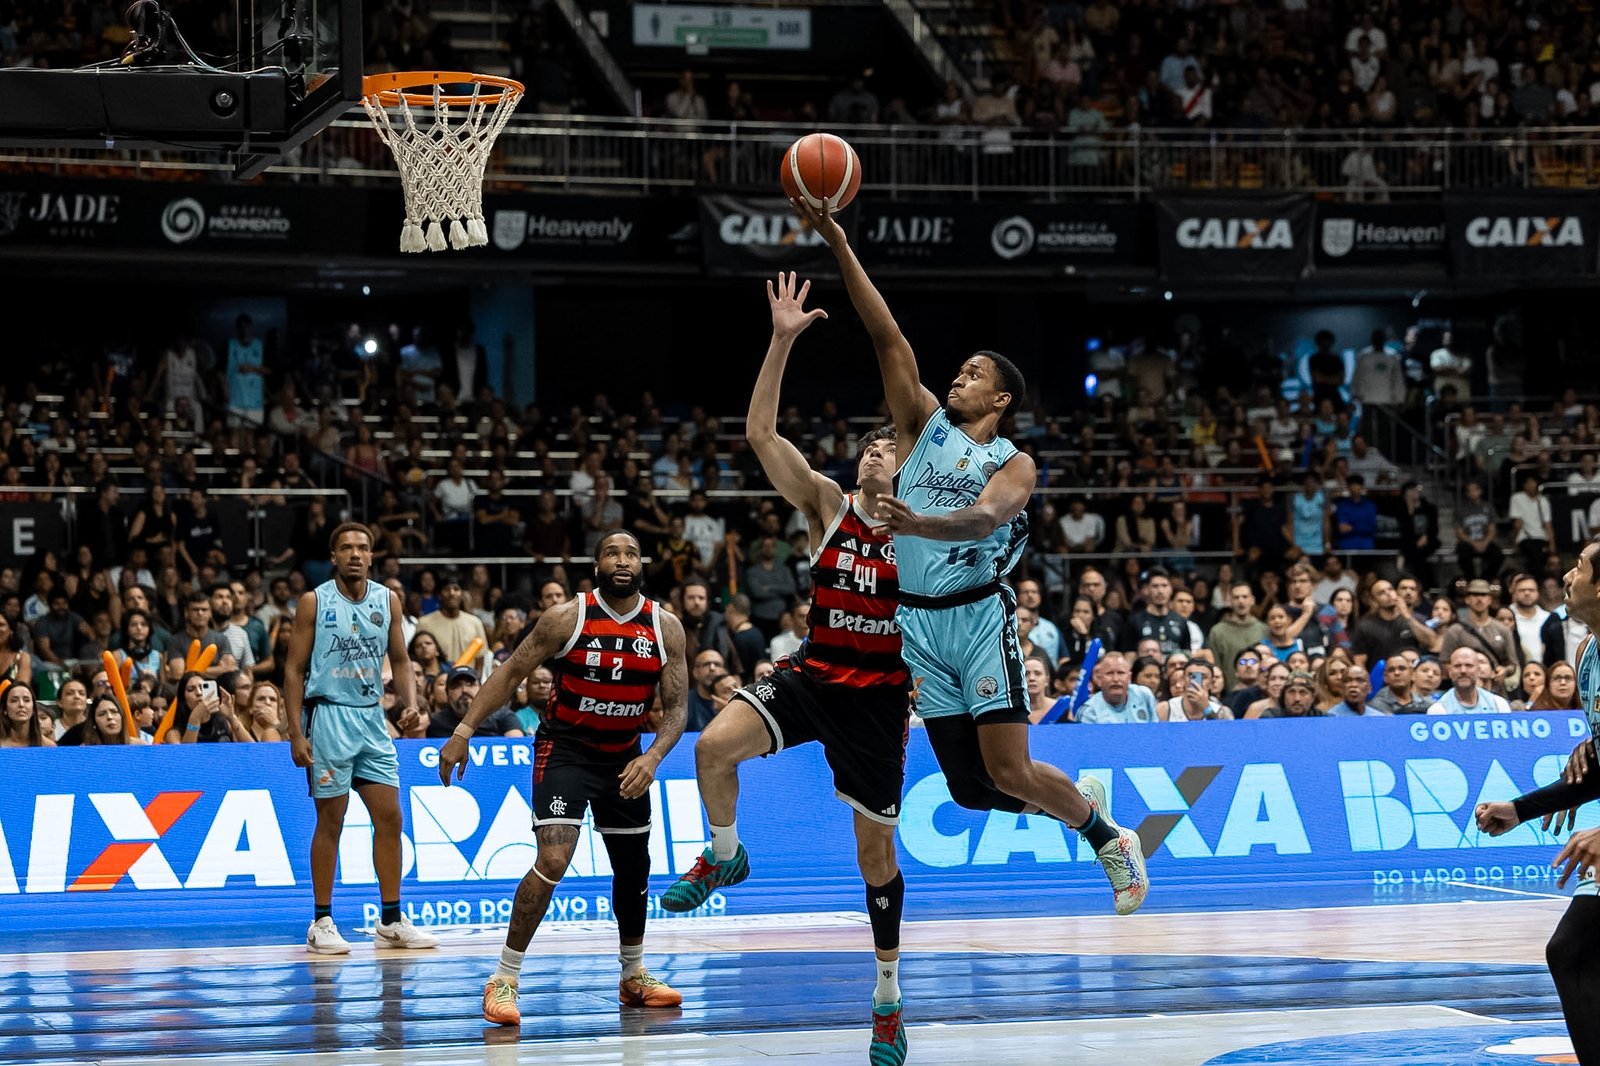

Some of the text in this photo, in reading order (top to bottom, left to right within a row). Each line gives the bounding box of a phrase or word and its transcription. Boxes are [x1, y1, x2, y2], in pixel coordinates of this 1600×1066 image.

[30, 193, 120, 223] JADE
[209, 216, 290, 232] MOVIMENTO
[528, 215, 633, 242] Heavenly
[868, 216, 954, 243] JADE
[1176, 218, 1293, 249] CAIXA
[1357, 222, 1446, 242] Heavenl
[1465, 217, 1584, 247] CAIXA
[1037, 233, 1117, 246] MOVIMENTO
[922, 488, 976, 510] Feder
[13, 518, 36, 555] E
[947, 546, 979, 567] 14
[854, 564, 877, 594] 44
[611, 657, 623, 681] 2
[579, 696, 645, 717] Betano
[1410, 718, 1550, 742] GOVERNO
[0, 789, 296, 894] IXA
[1373, 869, 1404, 885] DO
[1411, 867, 1466, 884] LADO
[1475, 865, 1504, 881] DO
[407, 900, 472, 920] LADO
[481, 899, 513, 917] DO
